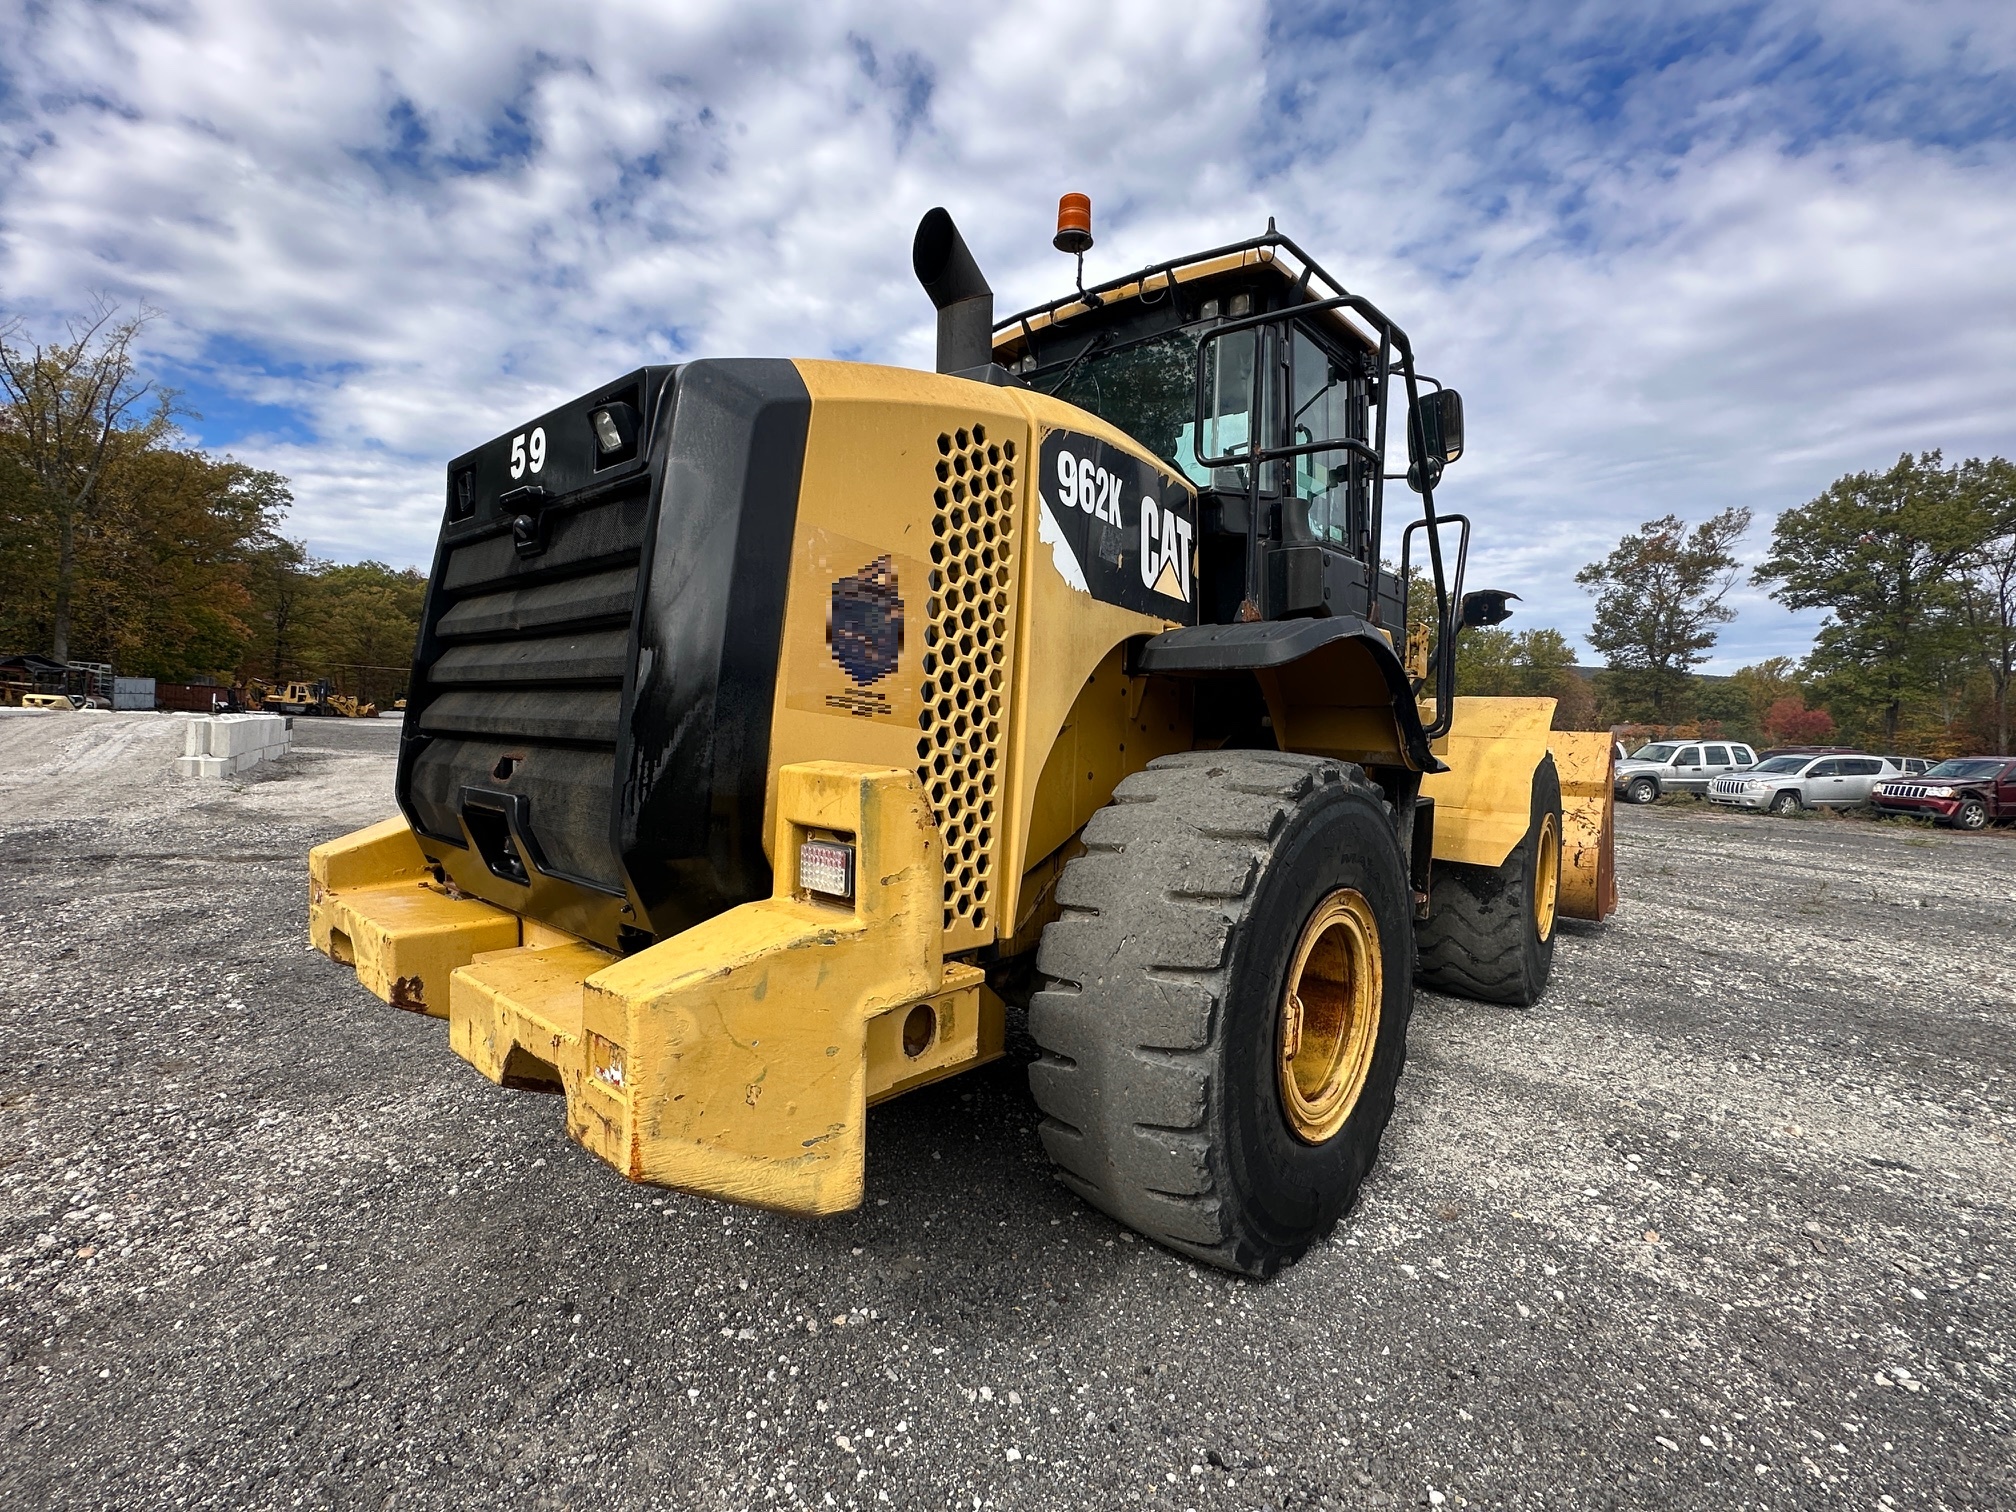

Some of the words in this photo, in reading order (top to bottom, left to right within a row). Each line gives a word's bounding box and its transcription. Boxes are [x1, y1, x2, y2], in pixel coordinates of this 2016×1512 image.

[511, 427, 546, 480] 59
[1057, 450, 1123, 530] 962K
[1140, 496, 1192, 603] CAT
